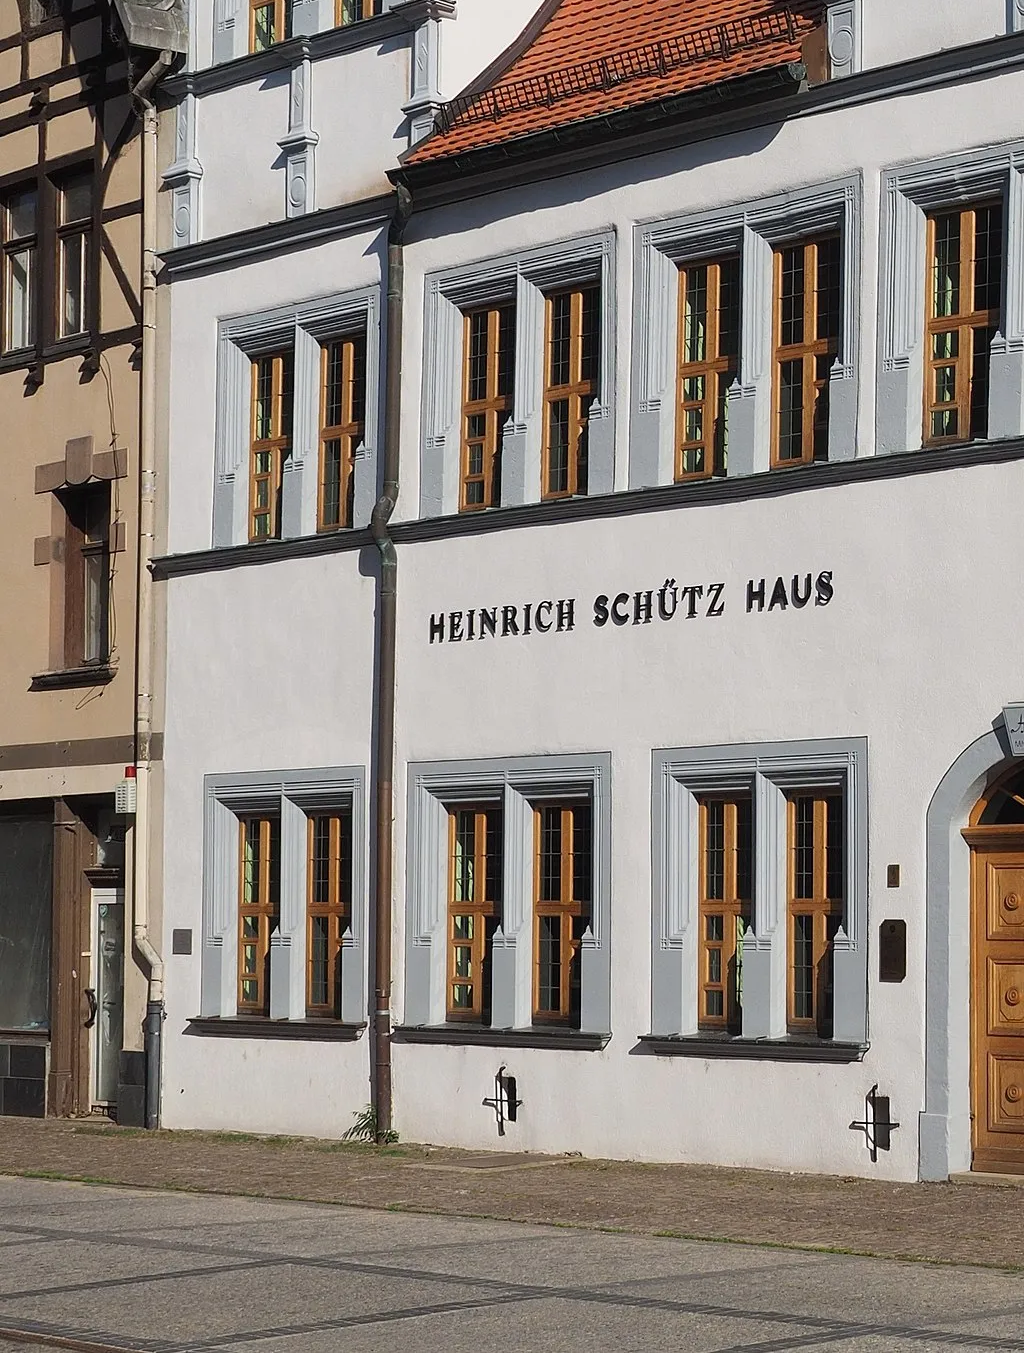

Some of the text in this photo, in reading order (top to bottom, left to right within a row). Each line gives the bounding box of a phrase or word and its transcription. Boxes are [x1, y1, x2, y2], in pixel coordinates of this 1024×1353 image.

[428, 570, 835, 644] HEINRICH SCHÜTZ HAUS
